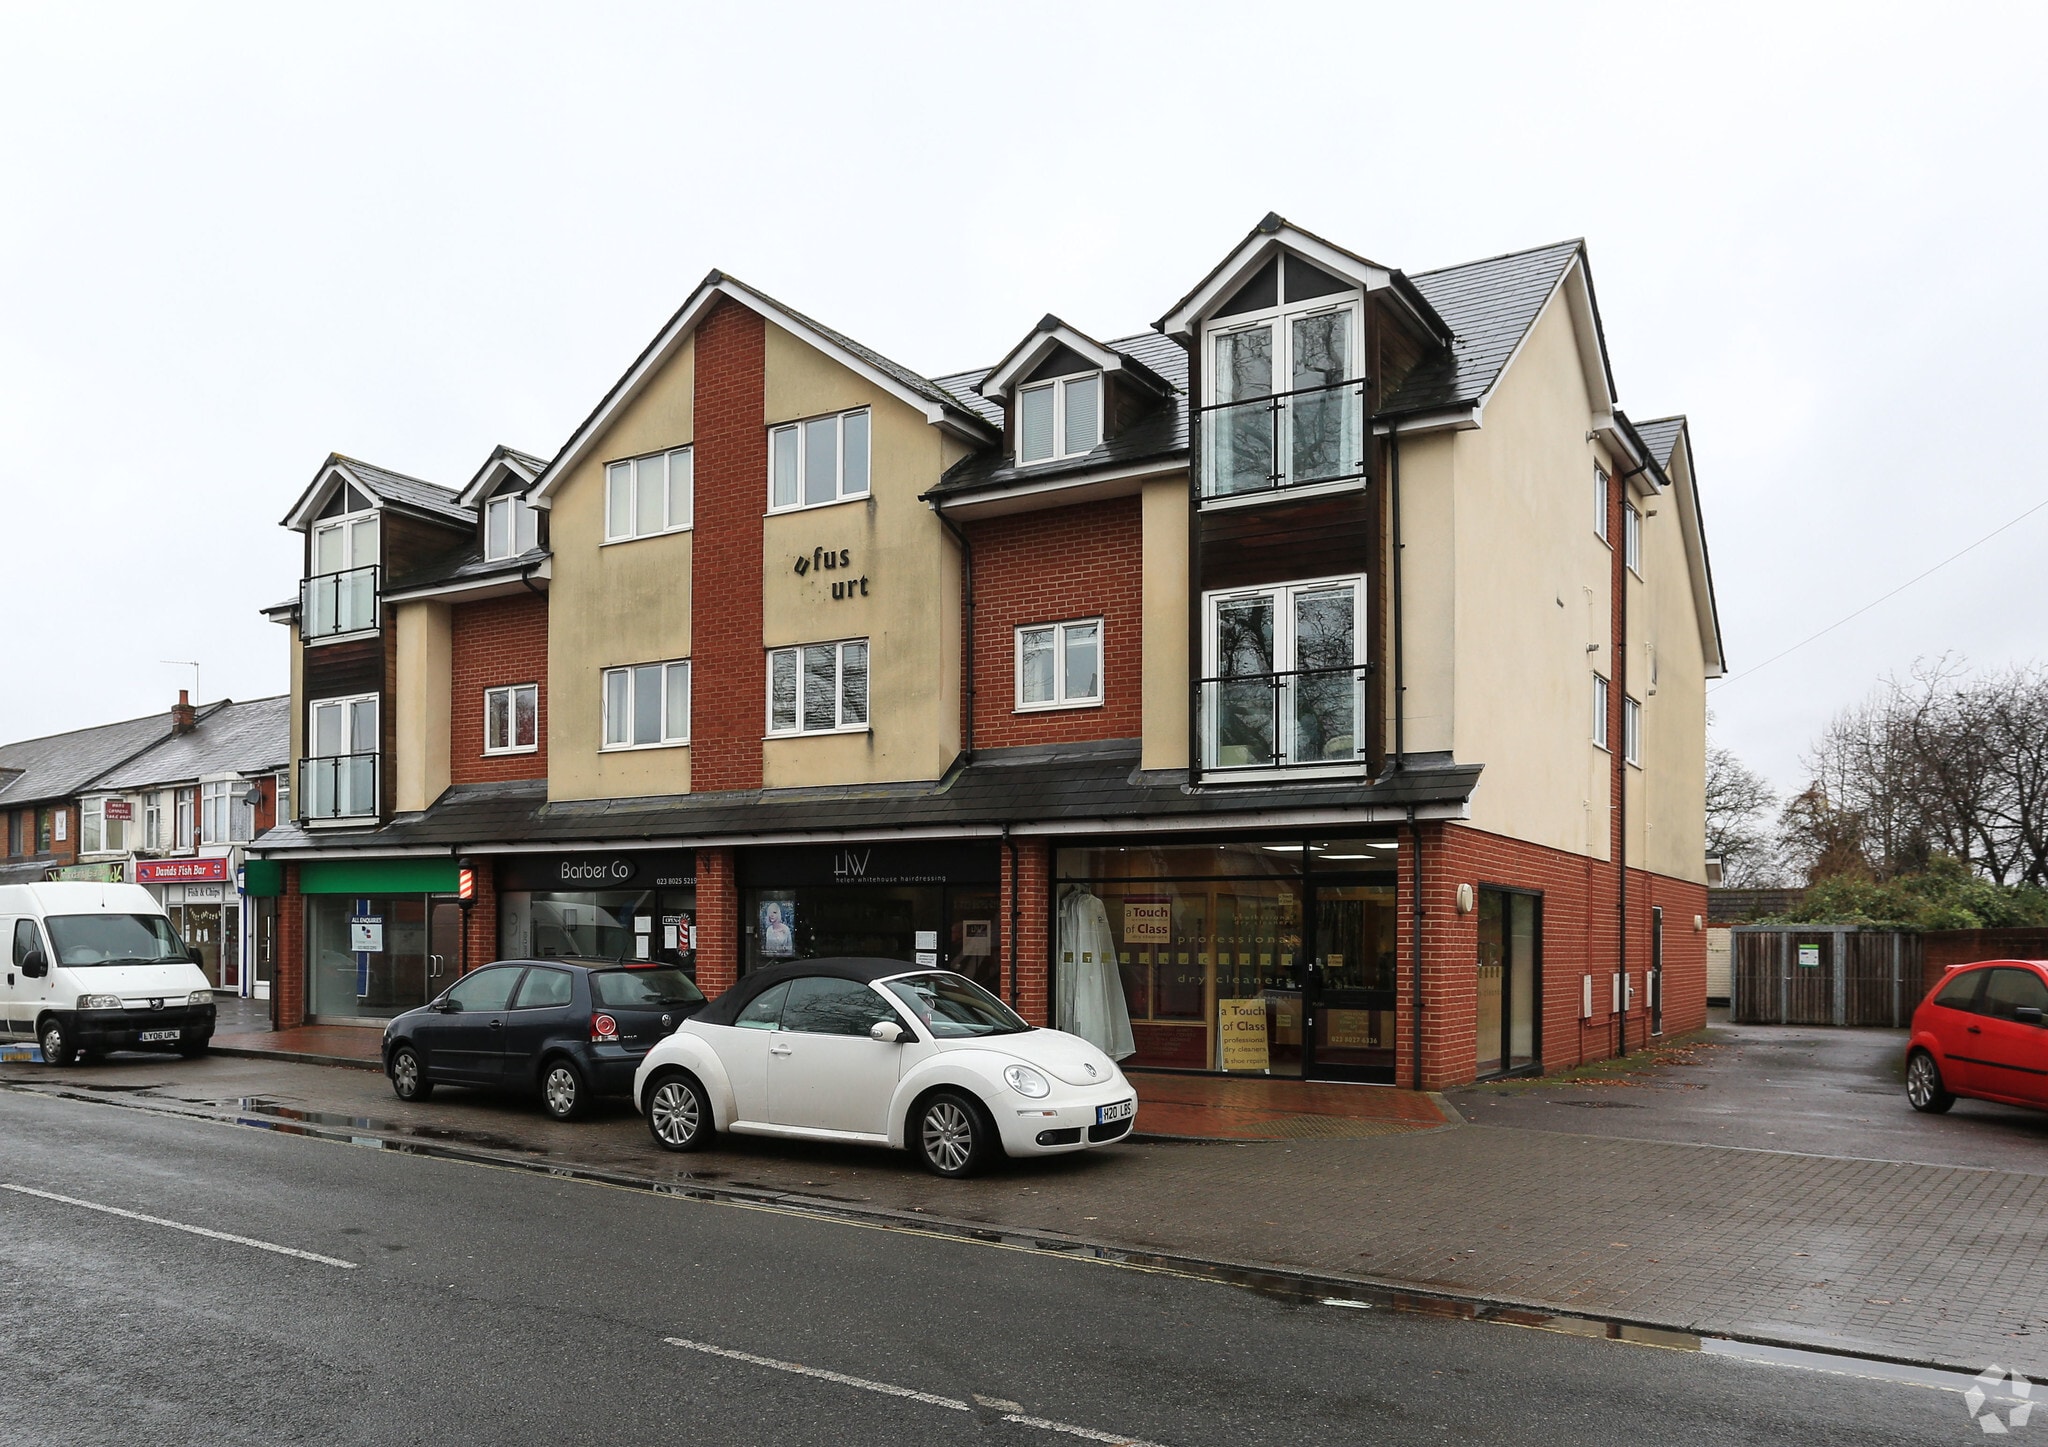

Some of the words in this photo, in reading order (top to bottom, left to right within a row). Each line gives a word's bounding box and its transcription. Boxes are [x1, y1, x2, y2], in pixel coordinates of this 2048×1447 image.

[832, 575, 868, 600] urt
[834, 849, 871, 876] HW
[155, 866, 177, 877] Davids
[178, 865, 193, 876] Fish
[193, 864, 206, 875] Bar
[561, 861, 607, 879] Barber
[611, 860, 628, 878] Co
[900, 875, 947, 883] hairdressing
[188, 887, 199, 897] Fish
[200, 888, 205, 897] &
[205, 887, 221, 898] Chips
[1126, 909, 1132, 917] a
[1133, 907, 1168, 918] Touch
[1126, 924, 1135, 934] of
[1137, 923, 1168, 934] Class
[1178, 975, 1206, 985] dry
[1216, 975, 1293, 985] cleaners
[1231, 1006, 1265, 1016] Touch
[1223, 1022, 1233, 1031] of
[1237, 1021, 1266, 1031] Class
